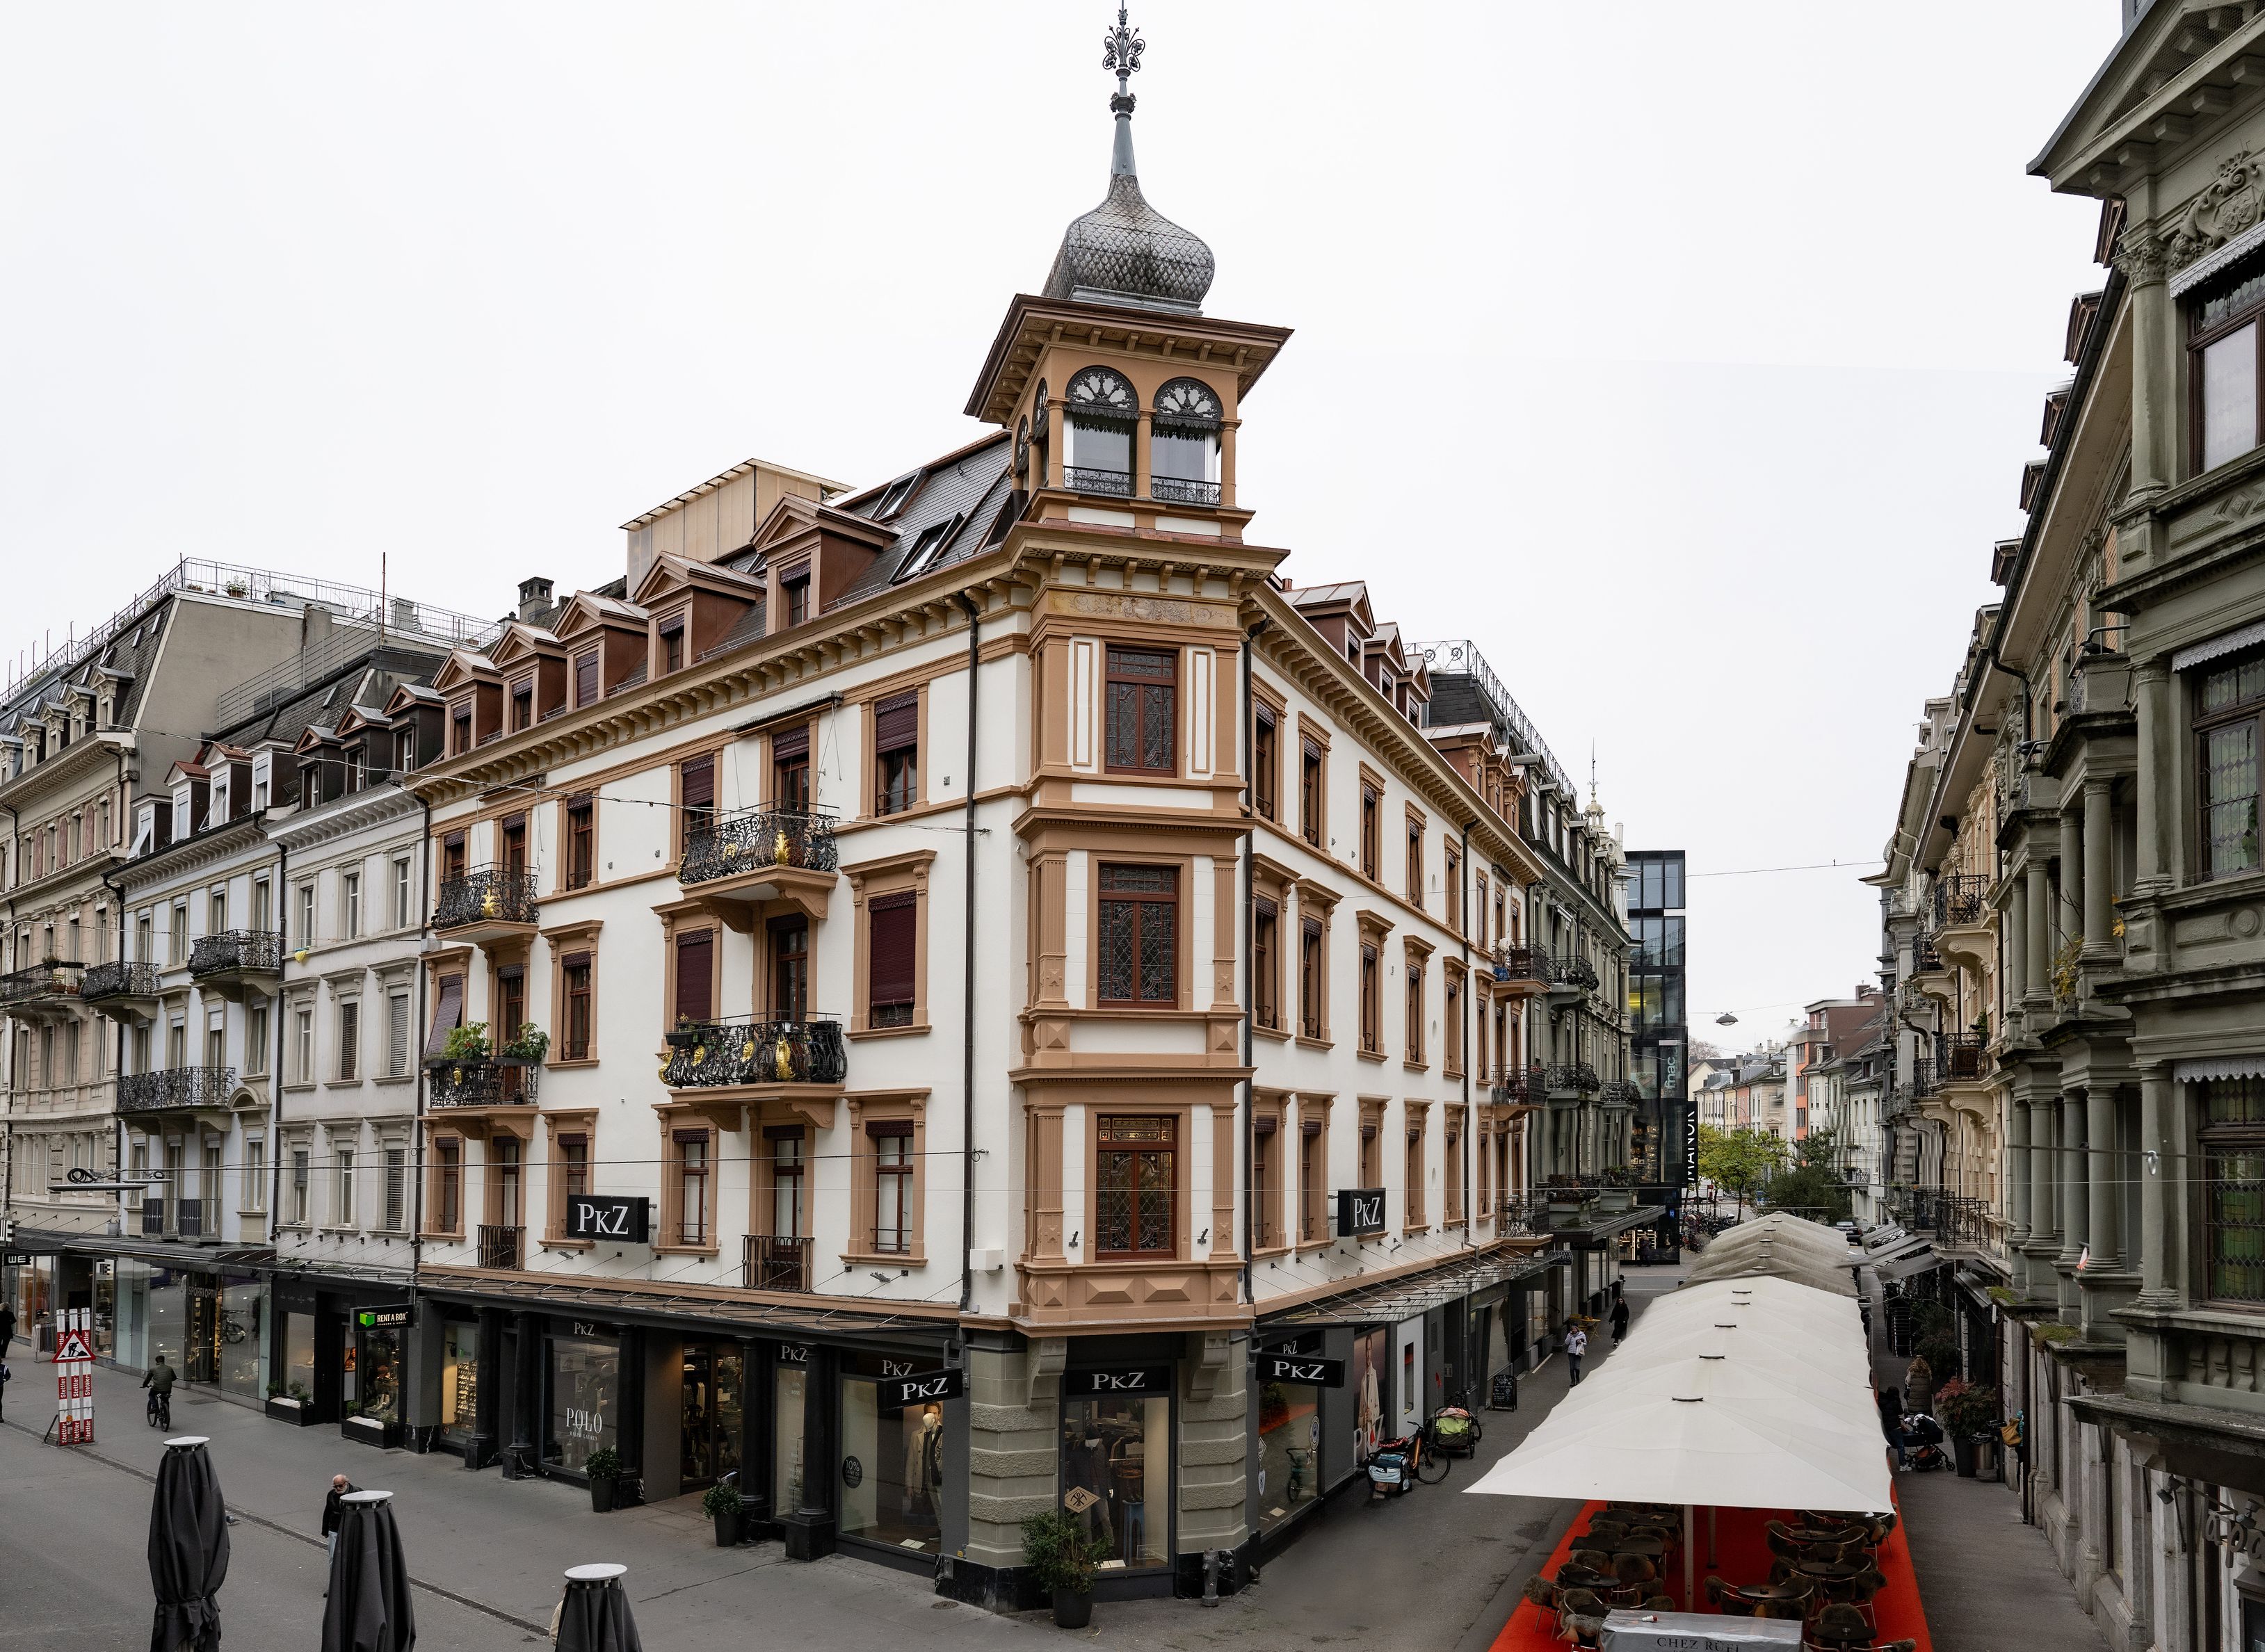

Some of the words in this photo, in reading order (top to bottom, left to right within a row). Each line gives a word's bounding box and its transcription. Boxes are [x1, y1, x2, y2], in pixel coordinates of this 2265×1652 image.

[1664, 1057, 1675, 1088] fnac
[577, 1204, 628, 1234] PKZ
[1353, 1197, 1380, 1227] PKZ
[377, 1314, 391, 1322] RENT
[396, 1313, 406, 1321] BOX
[574, 1322, 595, 1336] PKZ
[1283, 1341, 1297, 1355] PKZ
[1272, 1361, 1324, 1380] PKZ
[901, 1377, 948, 1400] PKZ
[1091, 1372, 1145, 1389] PKZ
[566, 1408, 602, 1433] POLO
[846, 1459, 860, 1472] 10%
[1657, 1637, 1698, 1650] CHEZ
